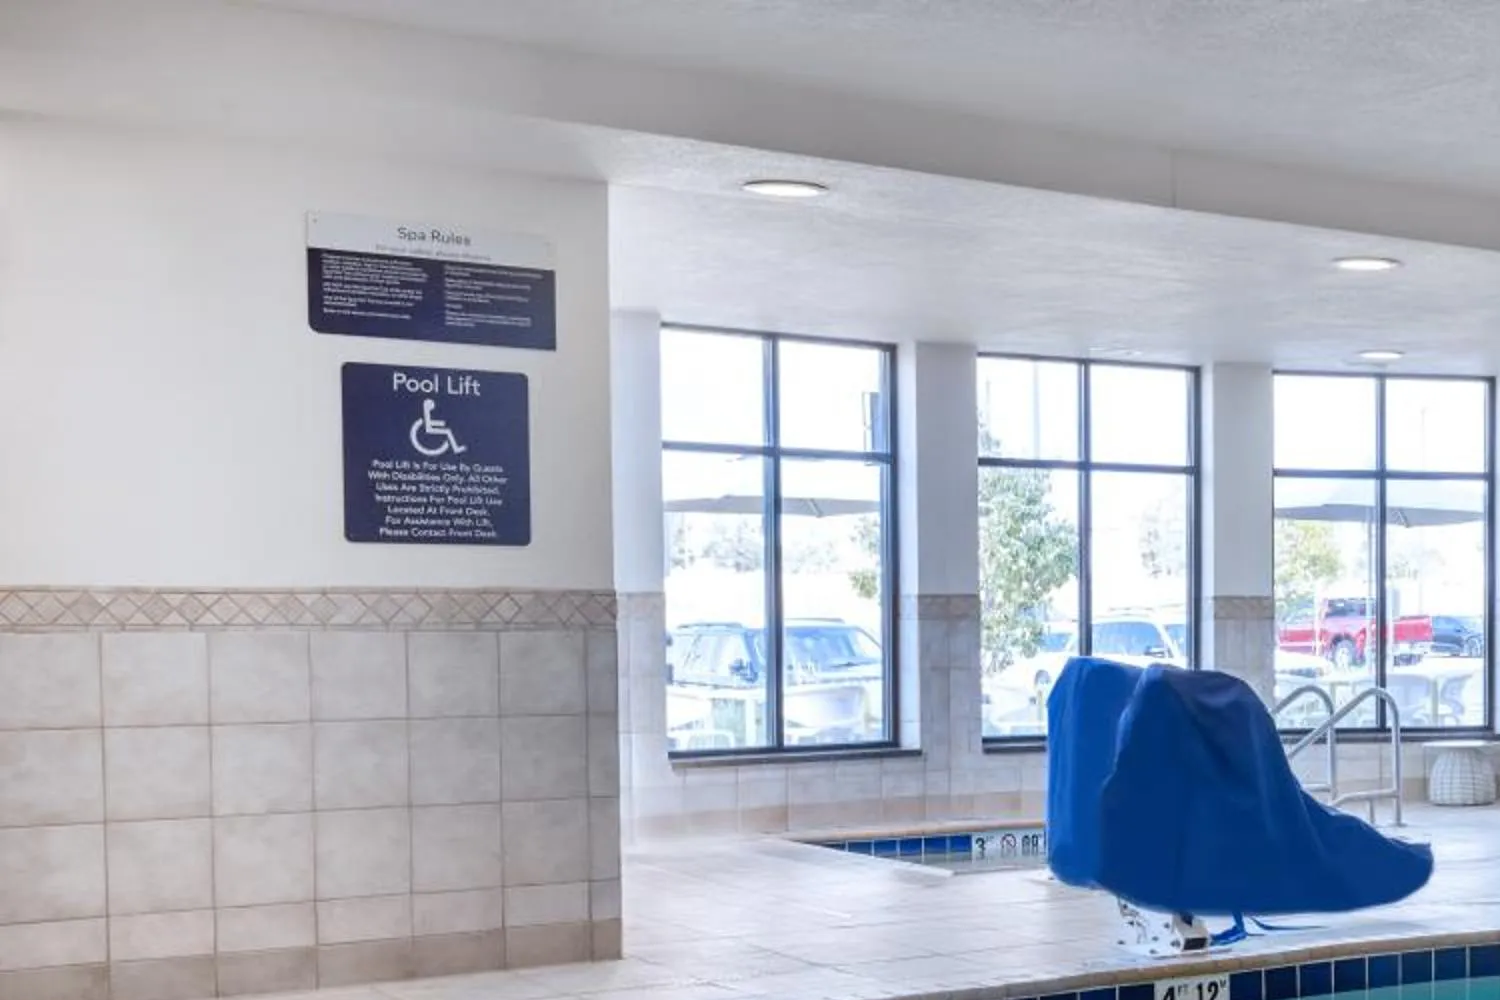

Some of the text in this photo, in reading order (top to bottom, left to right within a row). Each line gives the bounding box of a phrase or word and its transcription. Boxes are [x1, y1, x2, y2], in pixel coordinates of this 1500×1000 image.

[397, 227, 471, 246] Spa Rules
[393, 371, 480, 397] Pool Lift
[368, 470, 390, 480] With
